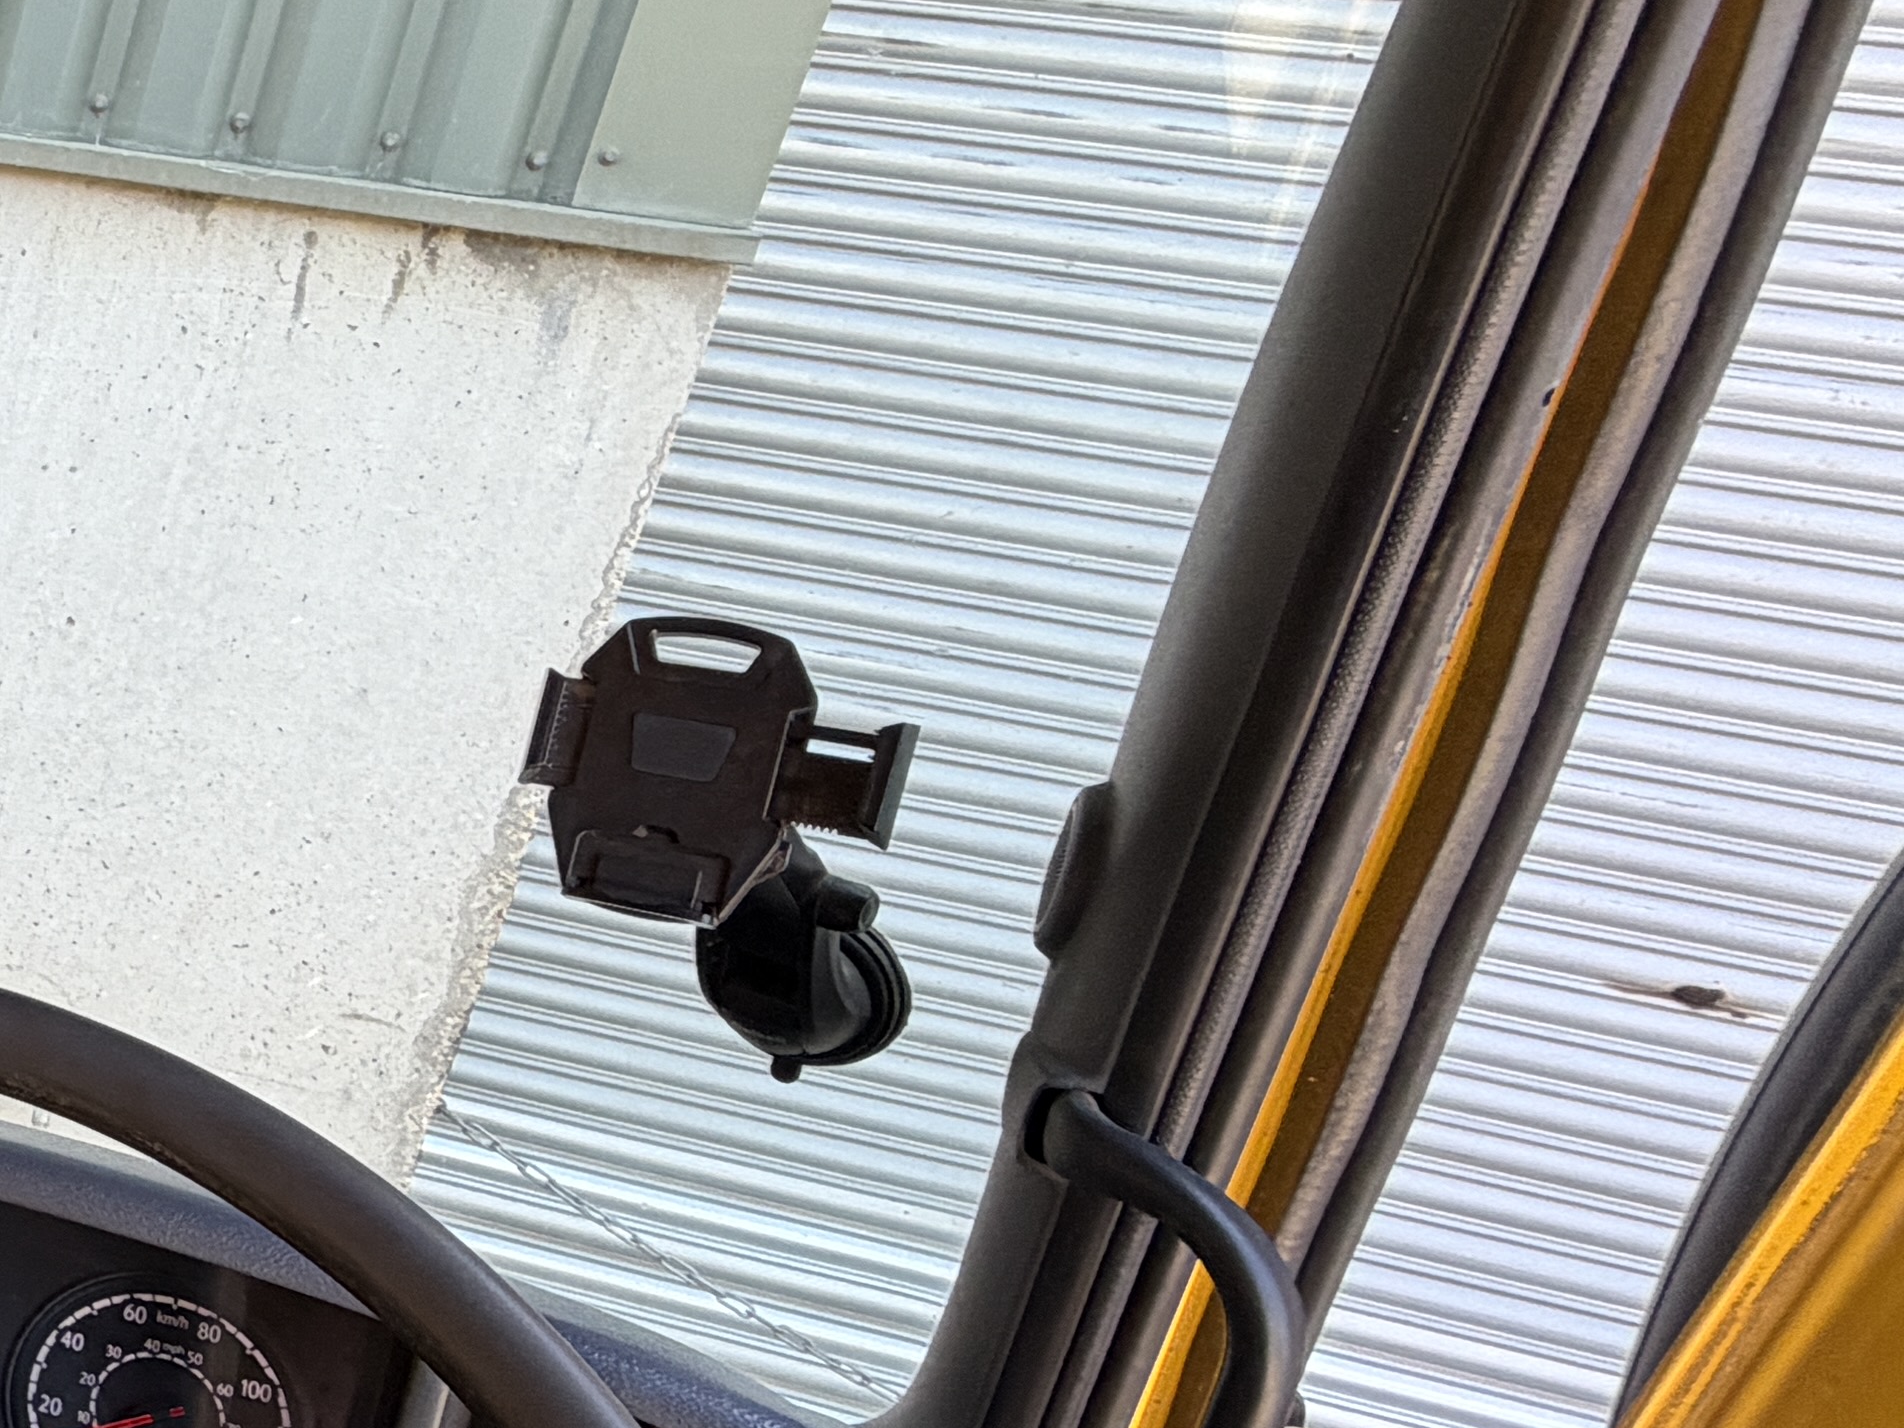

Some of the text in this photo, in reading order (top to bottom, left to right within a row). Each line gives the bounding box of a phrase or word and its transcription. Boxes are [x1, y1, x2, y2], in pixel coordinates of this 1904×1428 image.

[122, 1305, 149, 1326] 60
[155, 1309, 190, 1331] km/h
[59, 1331, 85, 1352] 40
[197, 1322, 223, 1344] 80
[104, 1344, 123, 1360] 30
[143, 1337, 161, 1353] 40
[161, 1341, 186, 1356] mph
[186, 1350, 204, 1367] 50
[78, 1371, 97, 1387] 20
[216, 1383, 234, 1399] 60
[240, 1378, 273, 1403] 100
[39, 1394, 64, 1416] 20
[76, 1409, 92, 1425] 10
